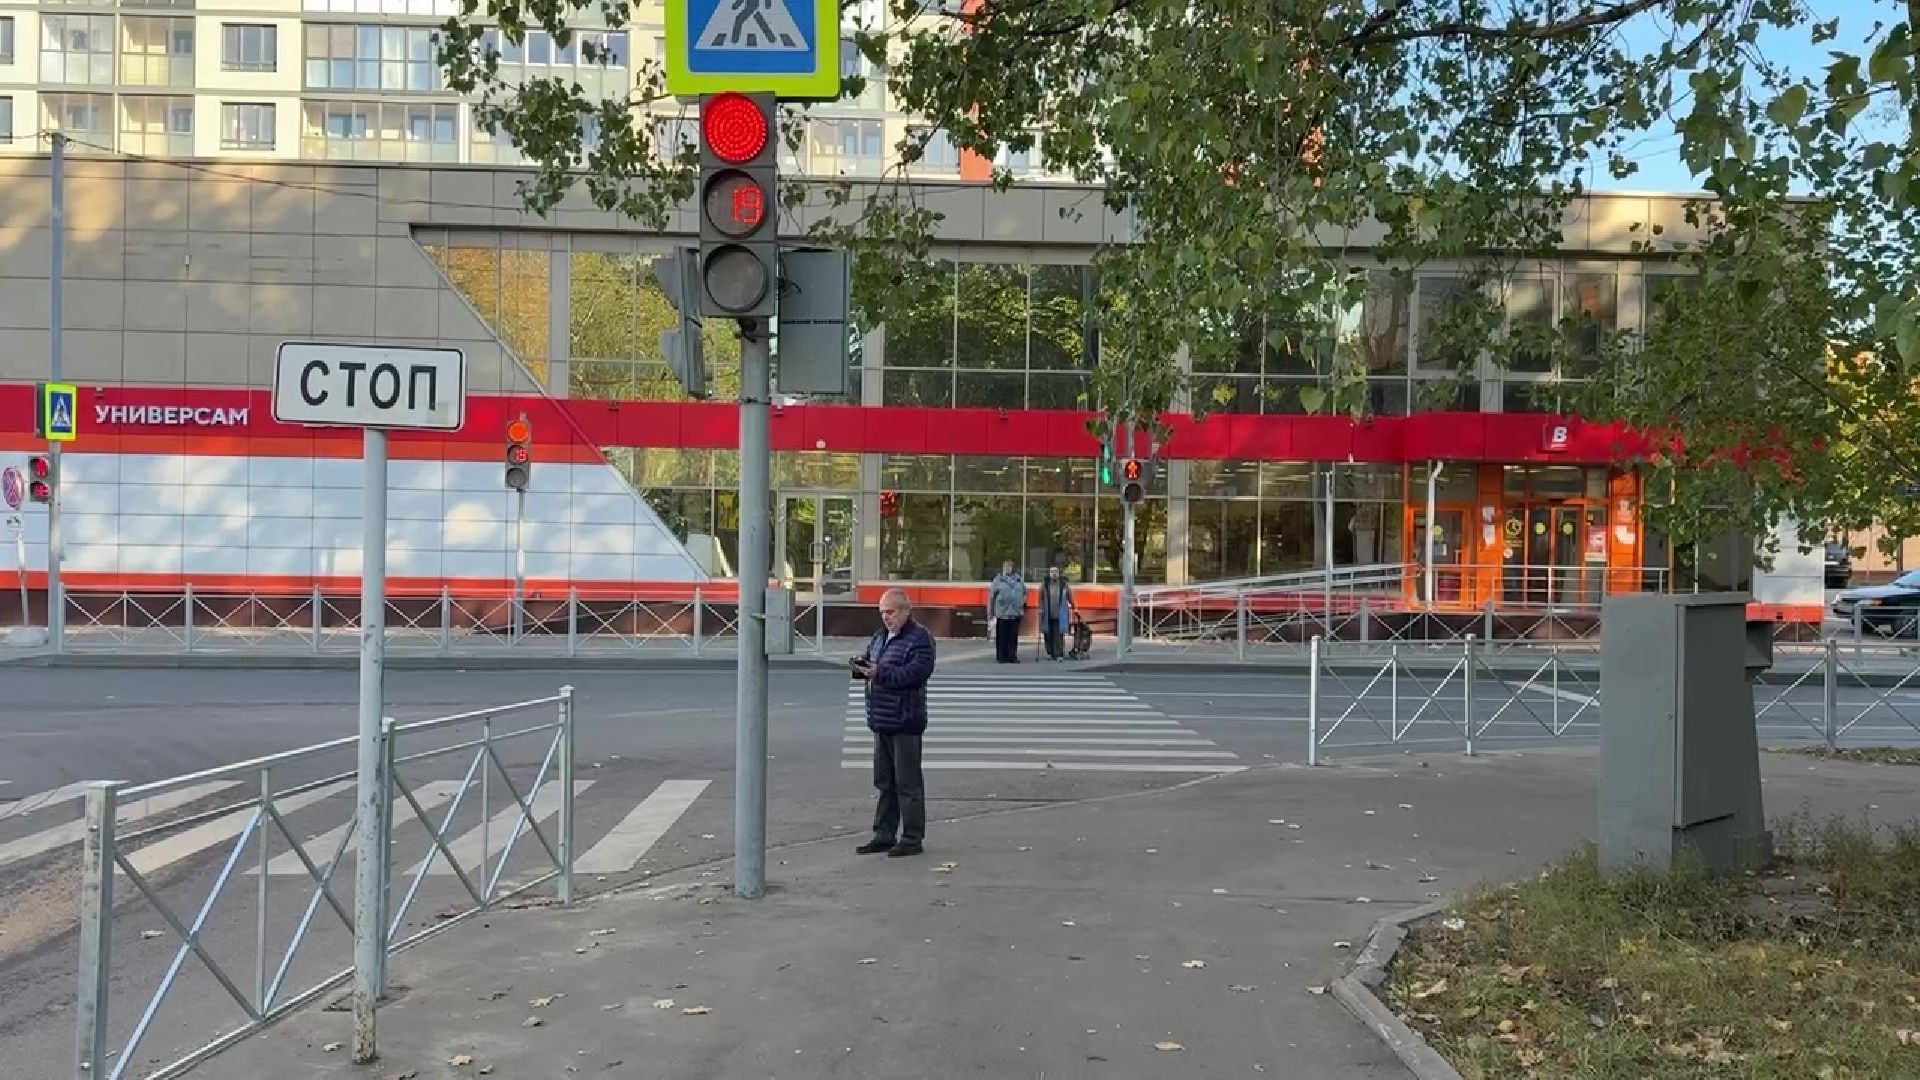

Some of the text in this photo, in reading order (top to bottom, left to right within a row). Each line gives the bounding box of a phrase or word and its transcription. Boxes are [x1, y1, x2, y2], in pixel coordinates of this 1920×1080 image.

[733, 187, 761, 223] 19
[300, 360, 436, 411] СТОП
[95, 405, 248, 425] УНИВЕРСАМ
